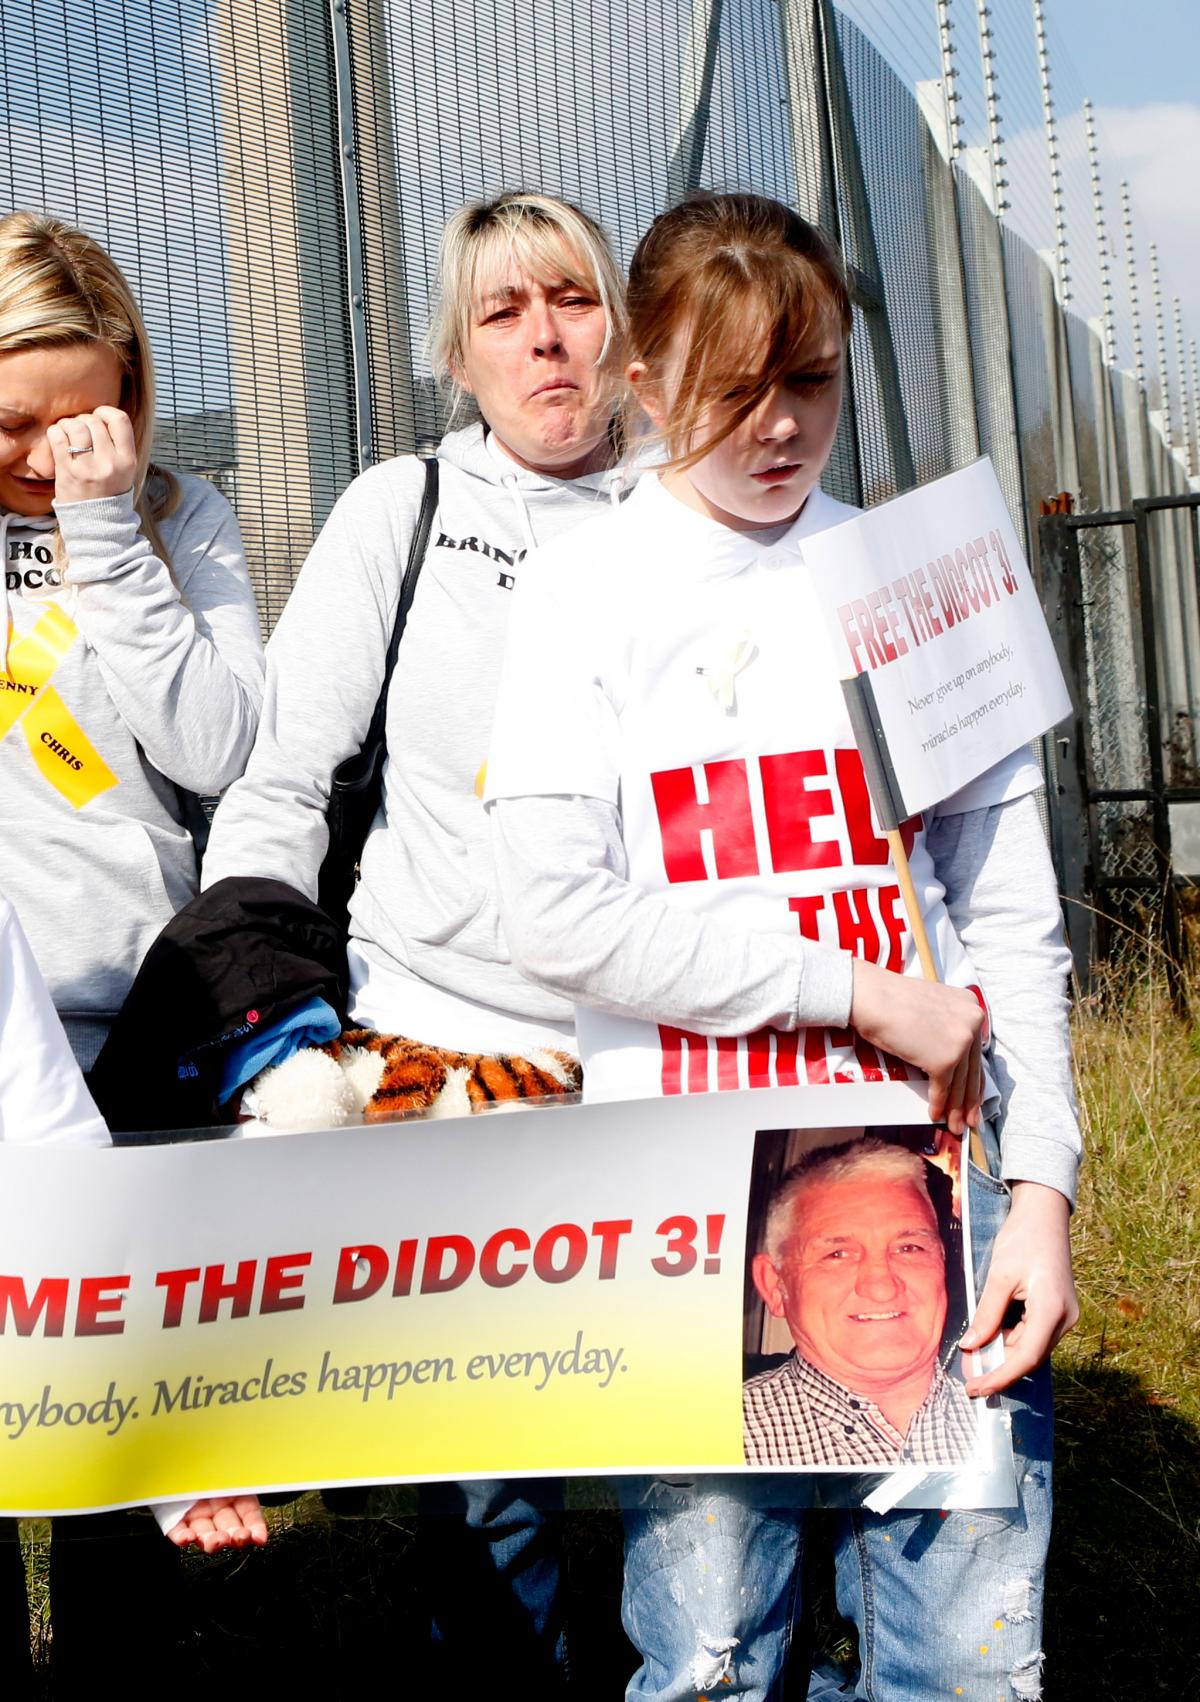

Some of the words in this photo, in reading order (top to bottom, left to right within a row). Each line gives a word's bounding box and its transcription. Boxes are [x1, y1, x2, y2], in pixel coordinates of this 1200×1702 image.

[837, 586, 909, 674] FREE
[892, 568, 944, 648] THE
[926, 537, 1000, 629] DIDCOT
[990, 528, 1019, 595] 3!
[907, 690, 935, 715] Never
[935, 681, 954, 704] give
[952, 674, 965, 690] up
[965, 667, 977, 681] on
[921, 721, 959, 752] miracles
[956, 703, 989, 731] happen
[40, 731, 84, 772] CHRIS
[650, 748, 924, 884] HEL
[788, 884, 908, 975] THE
[155, 1252, 313, 1330] THE
[333, 1219, 633, 1306] DIDCOT
[651, 1213, 726, 1277] 3!
[151, 1357, 308, 1417] Miracles
[317, 1351, 455, 1402] happen
[466, 1330, 628, 1390] everyday.
